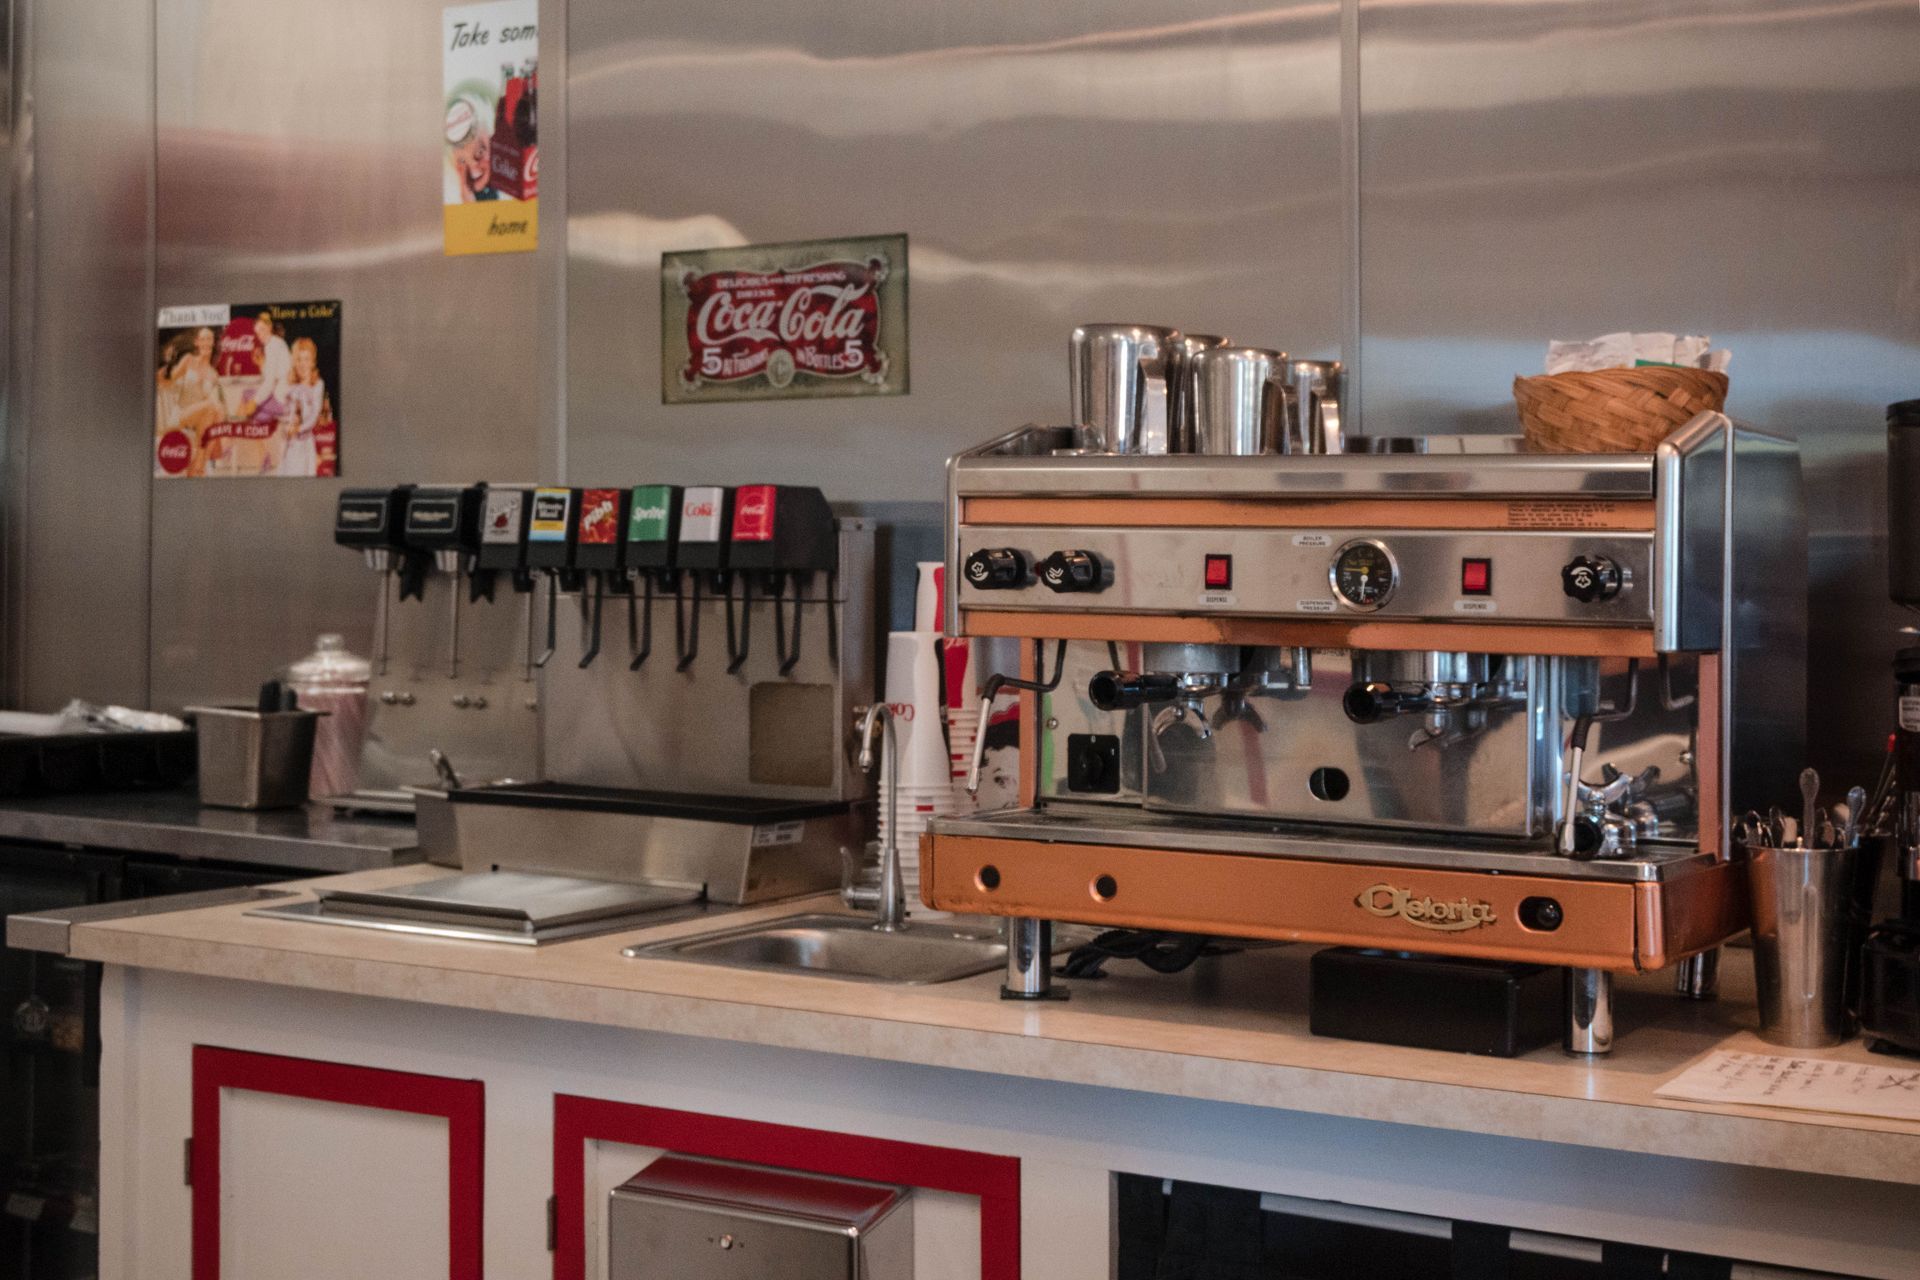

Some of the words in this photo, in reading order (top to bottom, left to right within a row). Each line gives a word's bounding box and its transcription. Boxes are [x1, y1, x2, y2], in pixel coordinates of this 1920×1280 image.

[451, 22, 489, 51] Take
[499, 25, 538, 43] som
[487, 213, 528, 236] home
[633, 506, 666, 522] Sprite
